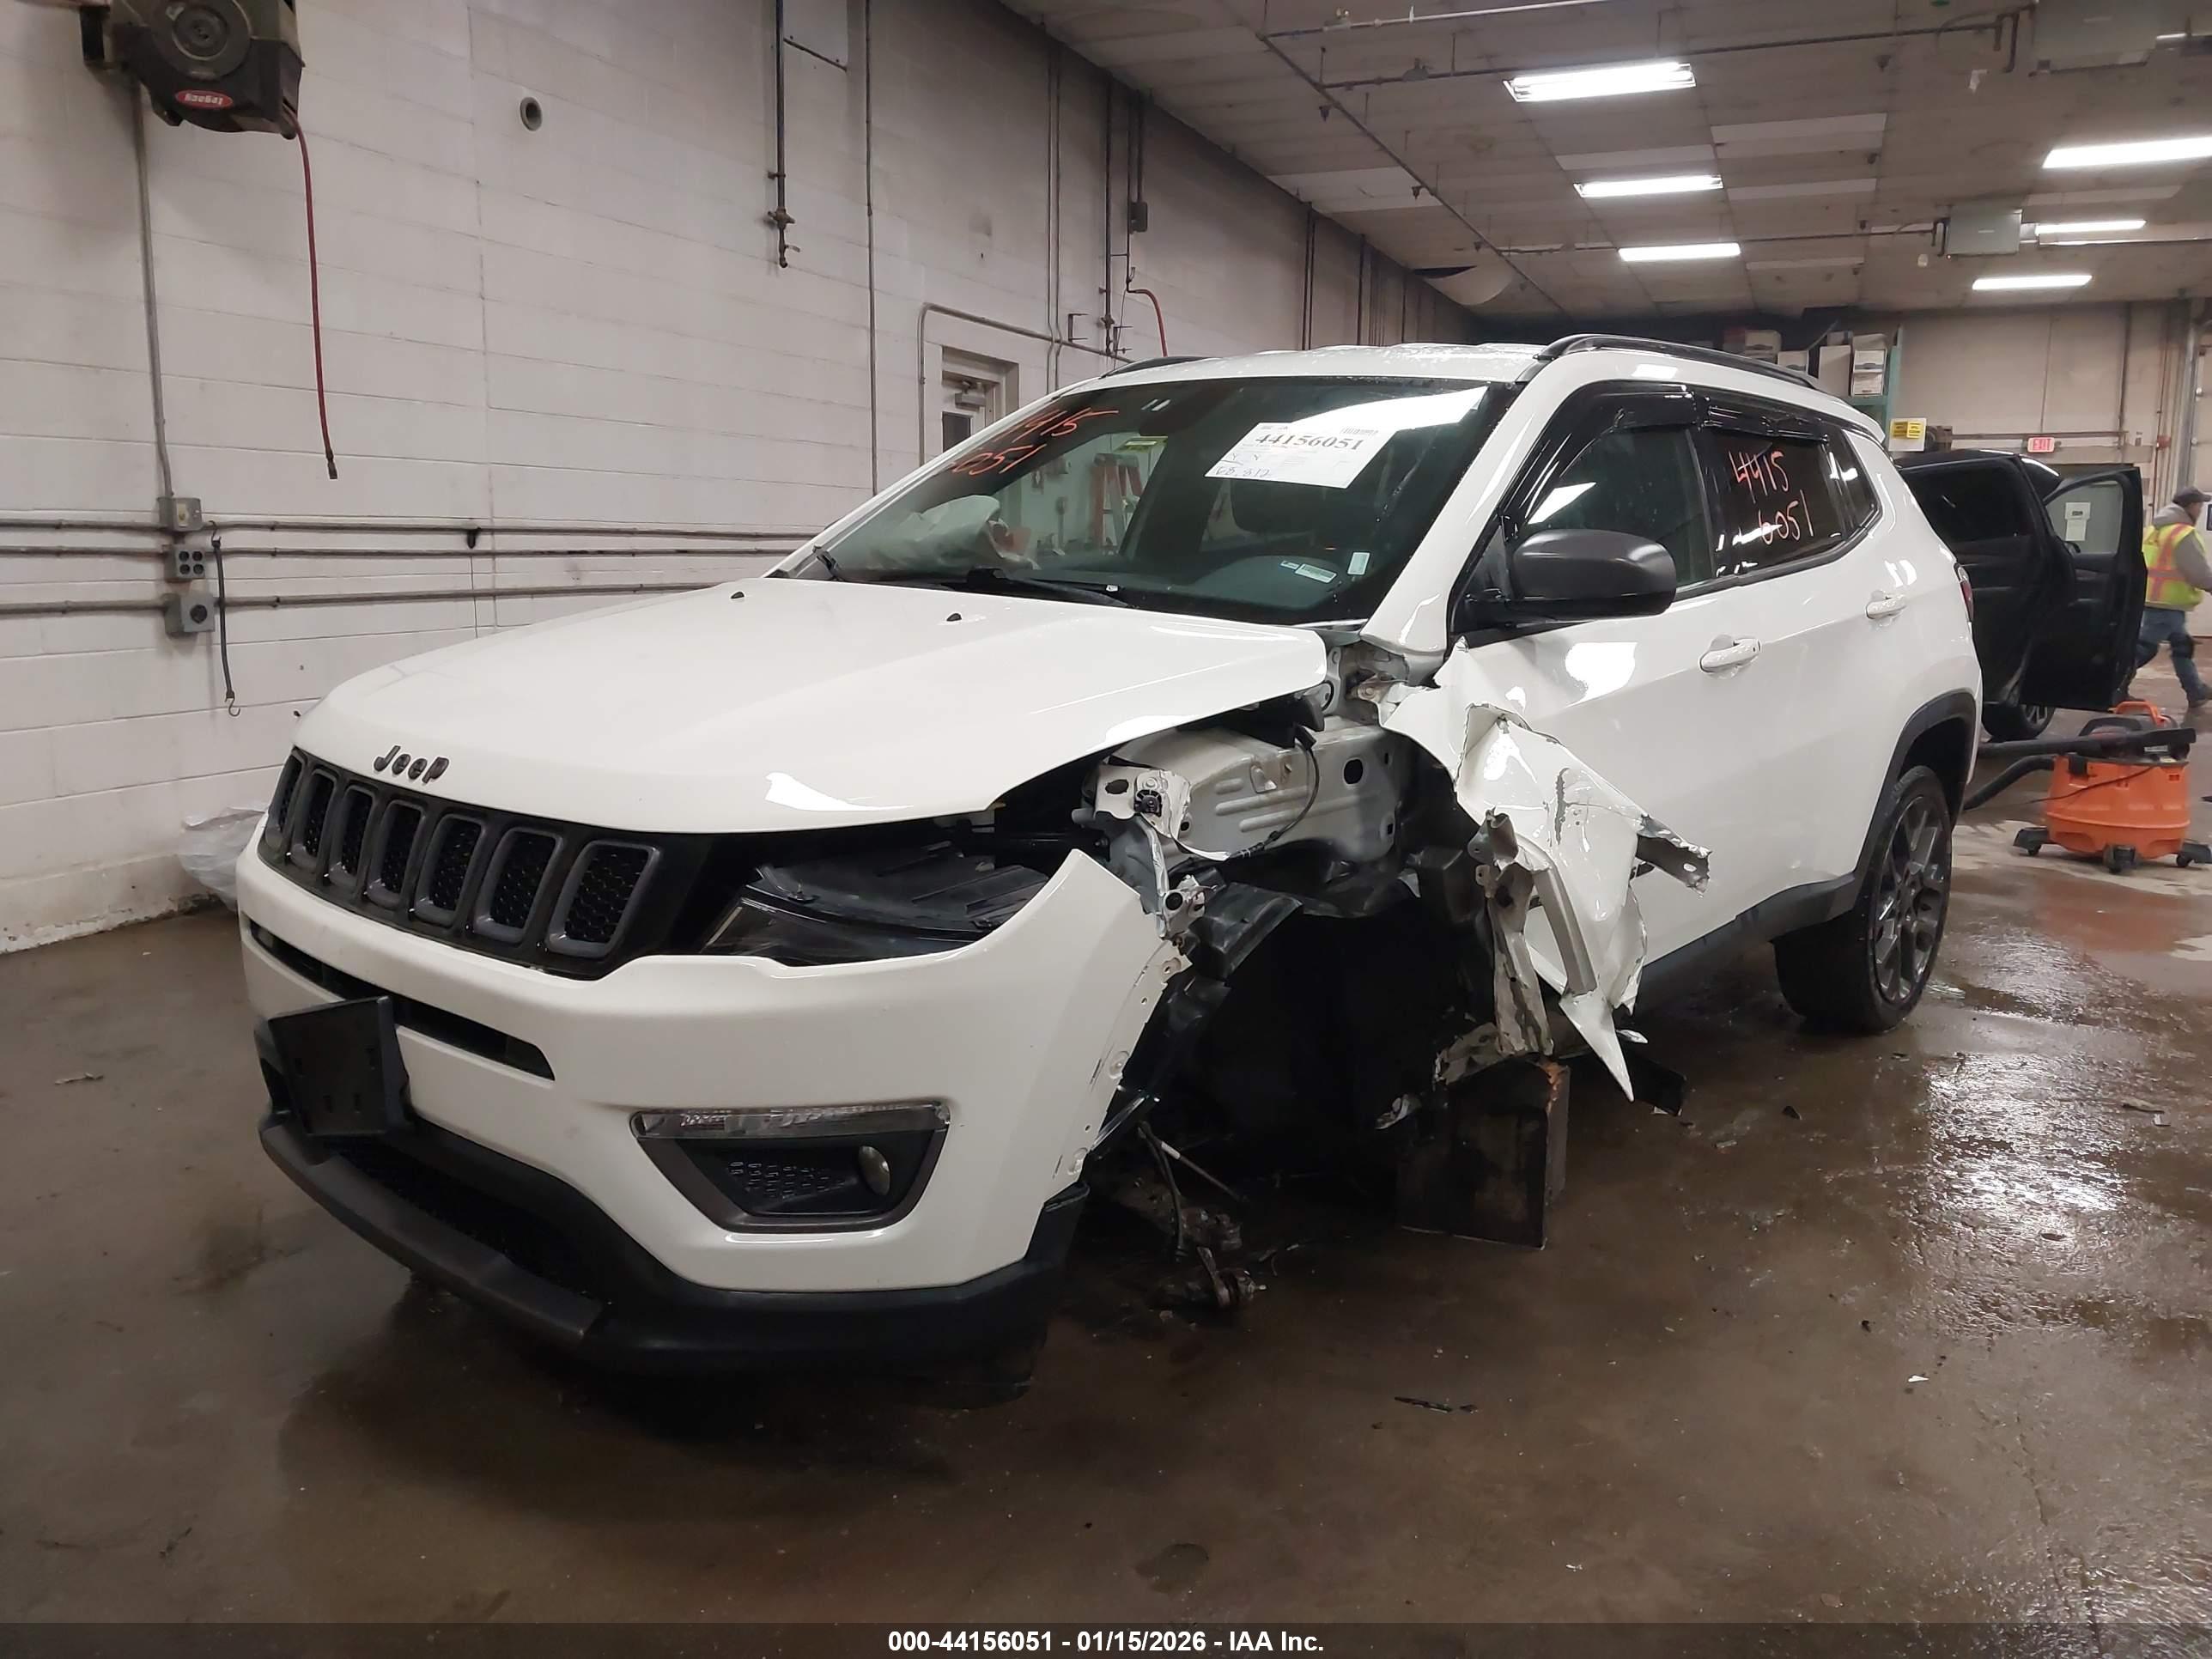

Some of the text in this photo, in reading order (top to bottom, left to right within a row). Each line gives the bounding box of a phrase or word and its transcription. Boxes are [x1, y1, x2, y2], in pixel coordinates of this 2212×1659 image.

[1255, 433, 1365, 451] 44156051
[2033, 438, 2051, 451] EXIT
[1728, 449, 1789, 505] 4415
[1758, 489, 1814, 545] 6051
[373, 744, 450, 784] Jeep
